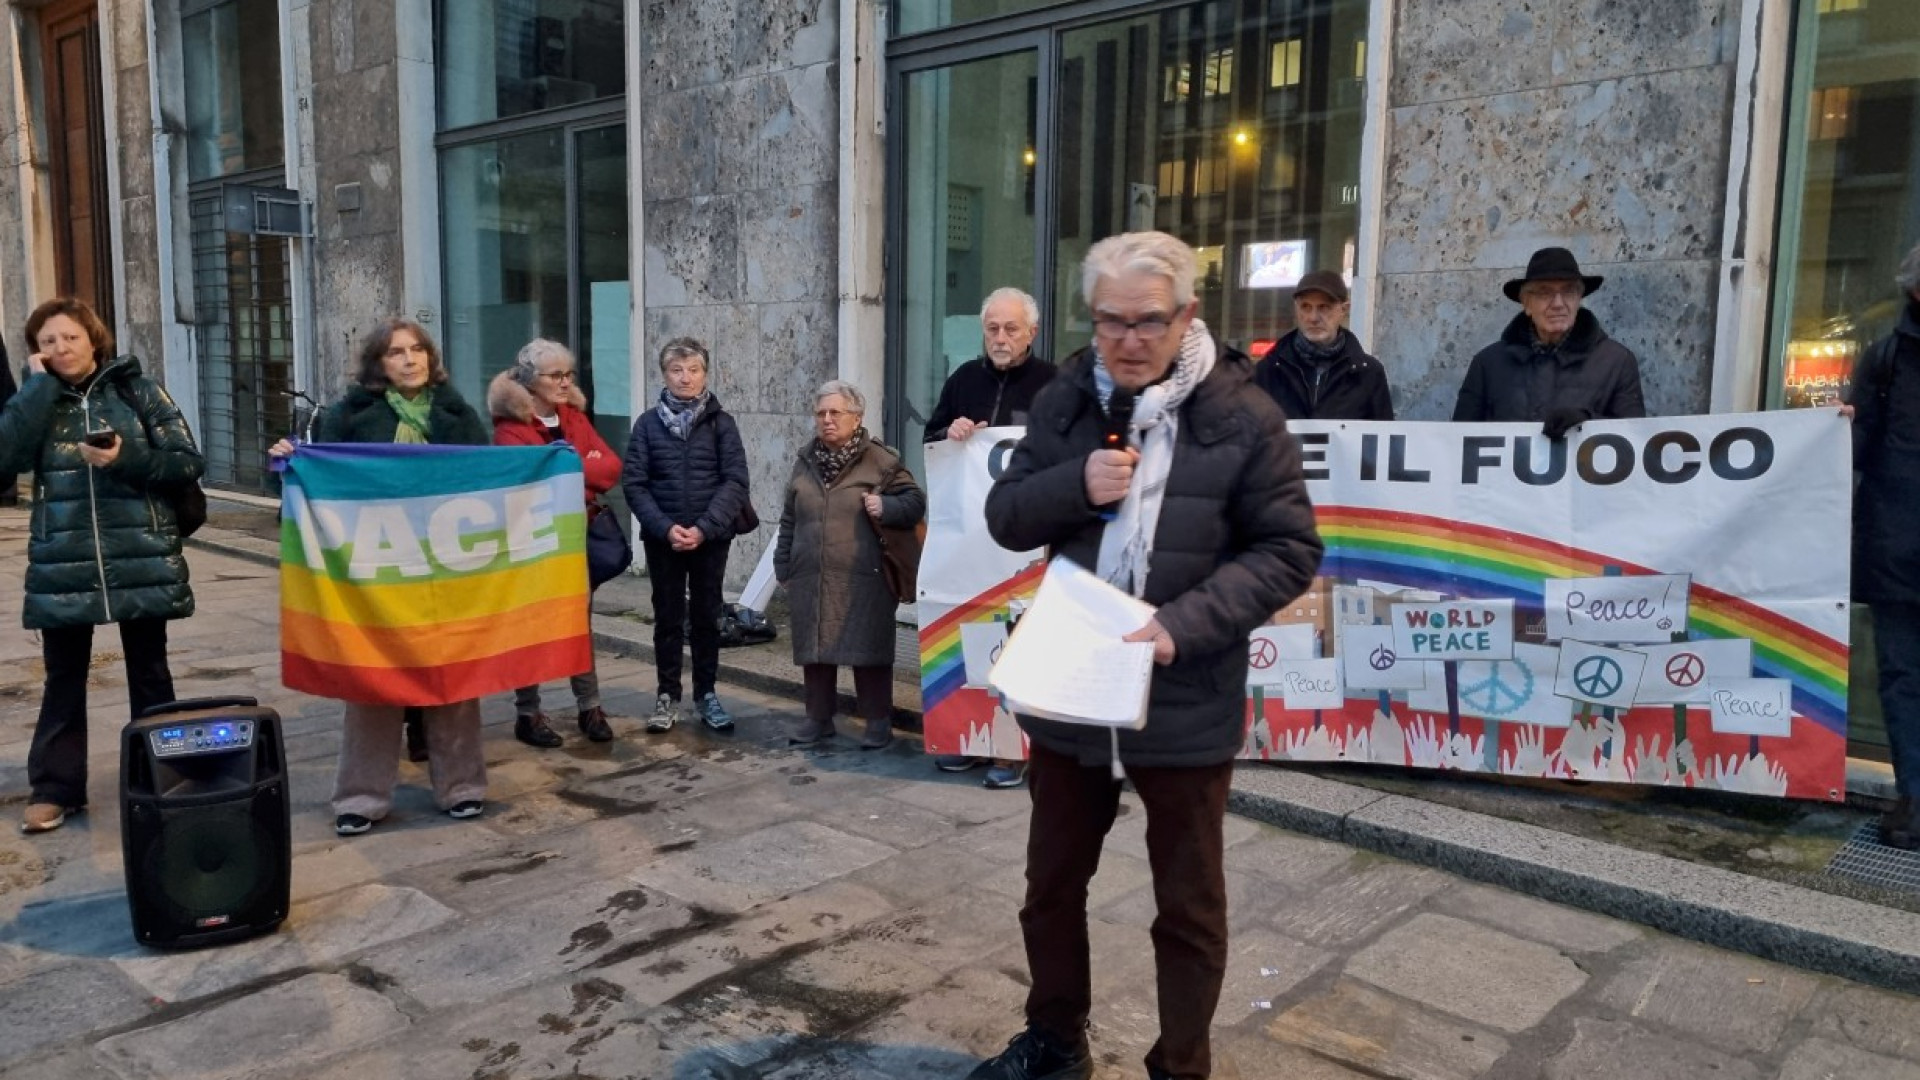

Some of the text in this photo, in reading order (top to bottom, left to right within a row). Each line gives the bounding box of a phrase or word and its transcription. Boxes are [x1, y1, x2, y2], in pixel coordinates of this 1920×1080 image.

[1360, 434, 1431, 482] IL
[1461, 426, 1775, 485] FUOCO
[300, 484, 559, 579] PACE
[1405, 608, 1496, 629] WORLD
[1411, 631, 1491, 653] PEACE
[1713, 689, 1783, 721] Peace!
